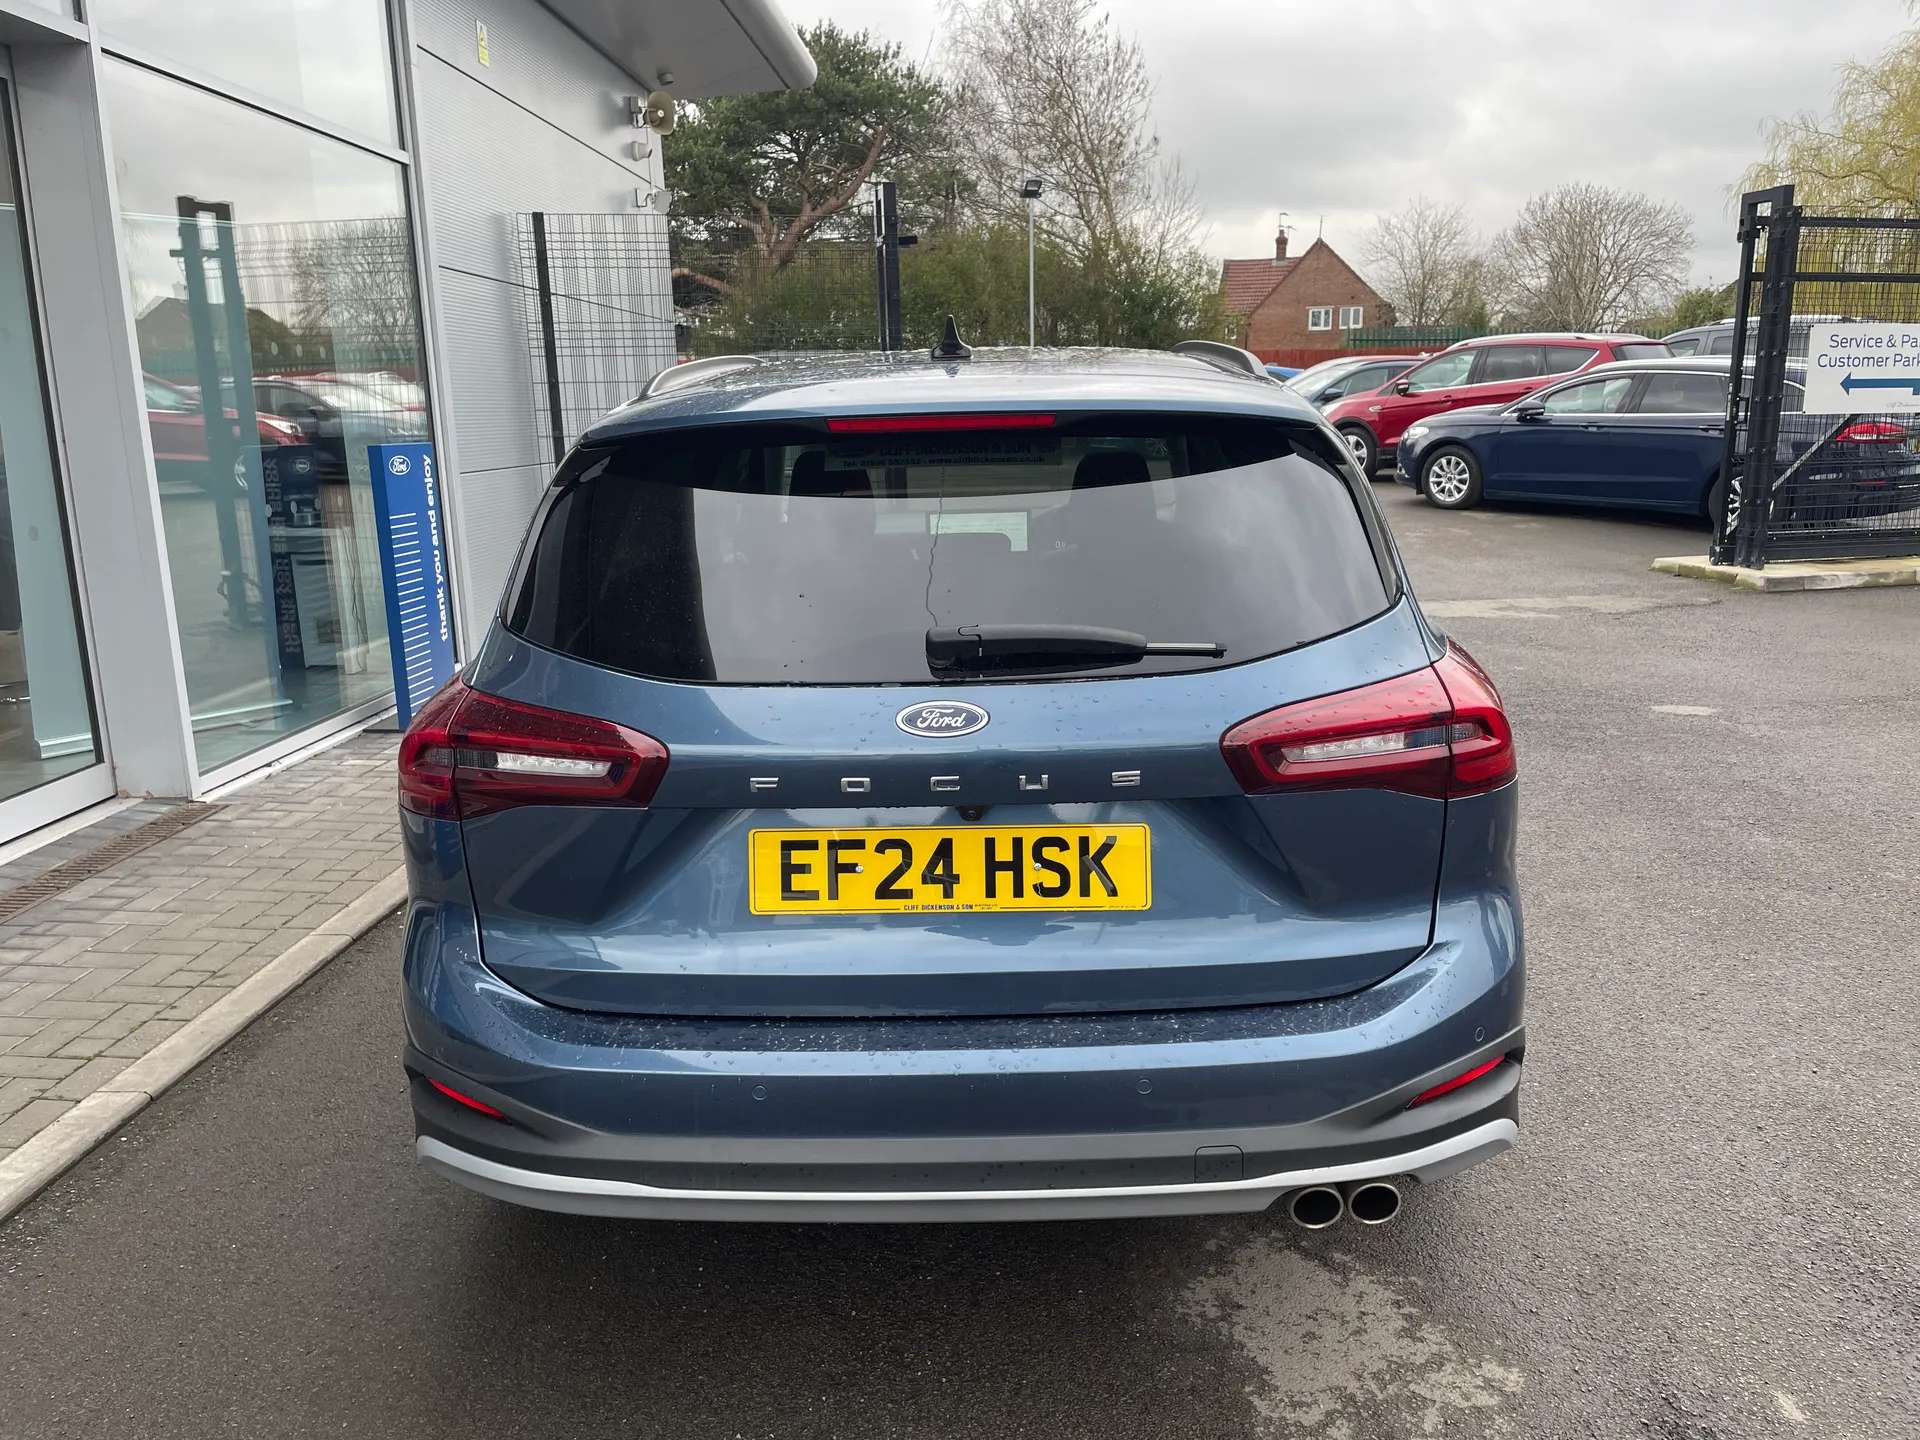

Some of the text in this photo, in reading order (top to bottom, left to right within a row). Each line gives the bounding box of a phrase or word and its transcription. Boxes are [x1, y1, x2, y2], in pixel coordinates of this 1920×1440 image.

[1829, 334, 1883, 348] Service
[1886, 334, 1897, 348] &
[1817, 354, 1889, 368] Customer
[392, 458, 408, 472] Ford
[423, 454, 449, 642] thank you and enjoy
[916, 708, 967, 728] Ford
[749, 769, 1142, 793] FOCUS
[781, 835, 1119, 900] EF24 HSK
